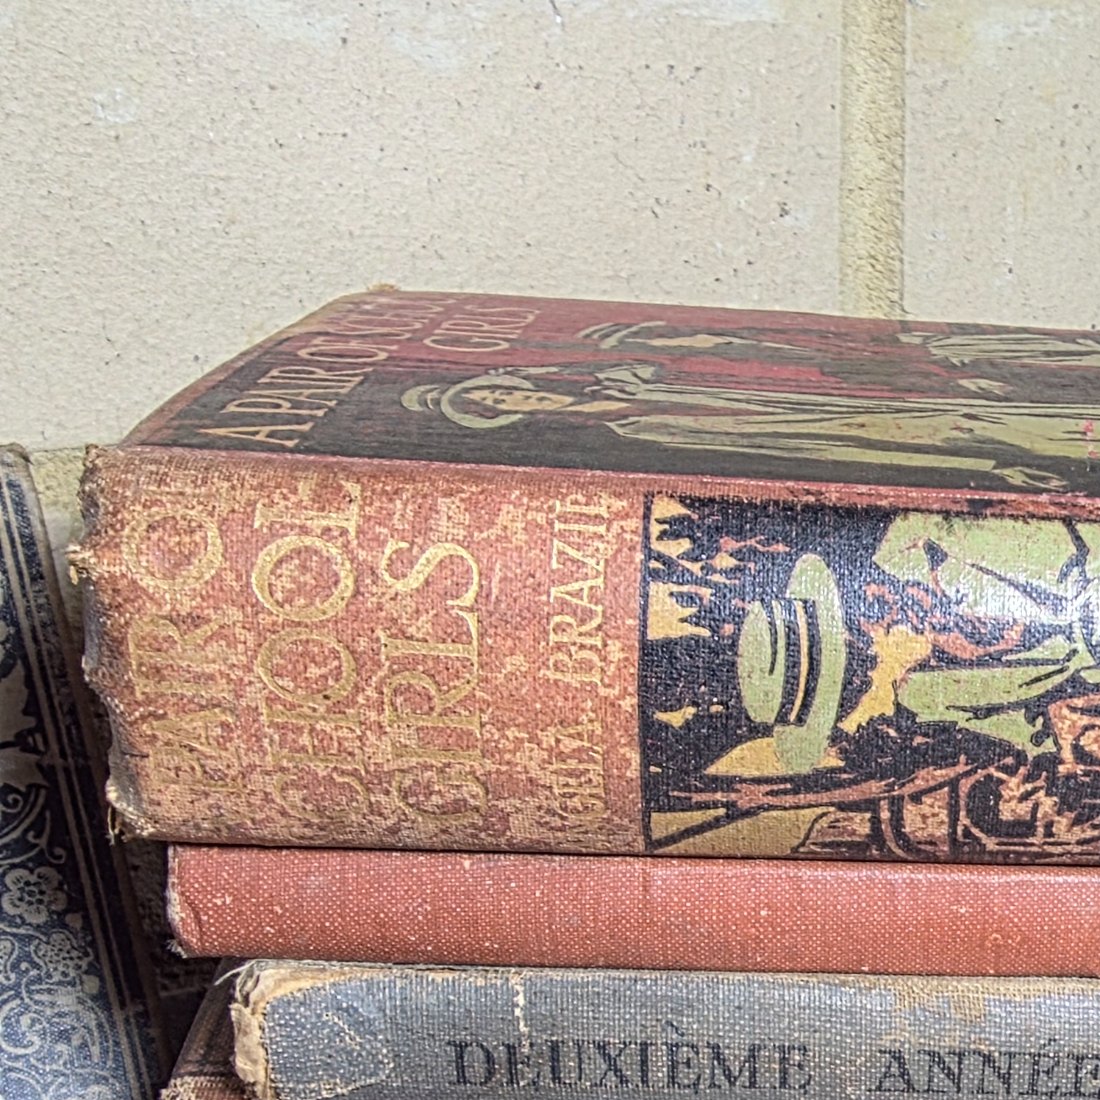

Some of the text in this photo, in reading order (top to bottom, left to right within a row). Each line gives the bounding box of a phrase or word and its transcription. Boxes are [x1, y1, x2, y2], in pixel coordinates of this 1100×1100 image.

[296, 334, 398, 363] OF
[421, 304, 540, 352] GIRLS
[221, 366, 373, 417] PAIR
[201, 421, 314, 448] A
[250, 480, 368, 840] CHOOL
[379, 538, 487, 822] GIRLS
[444, 1020, 813, 1093] DEUXIÈME
